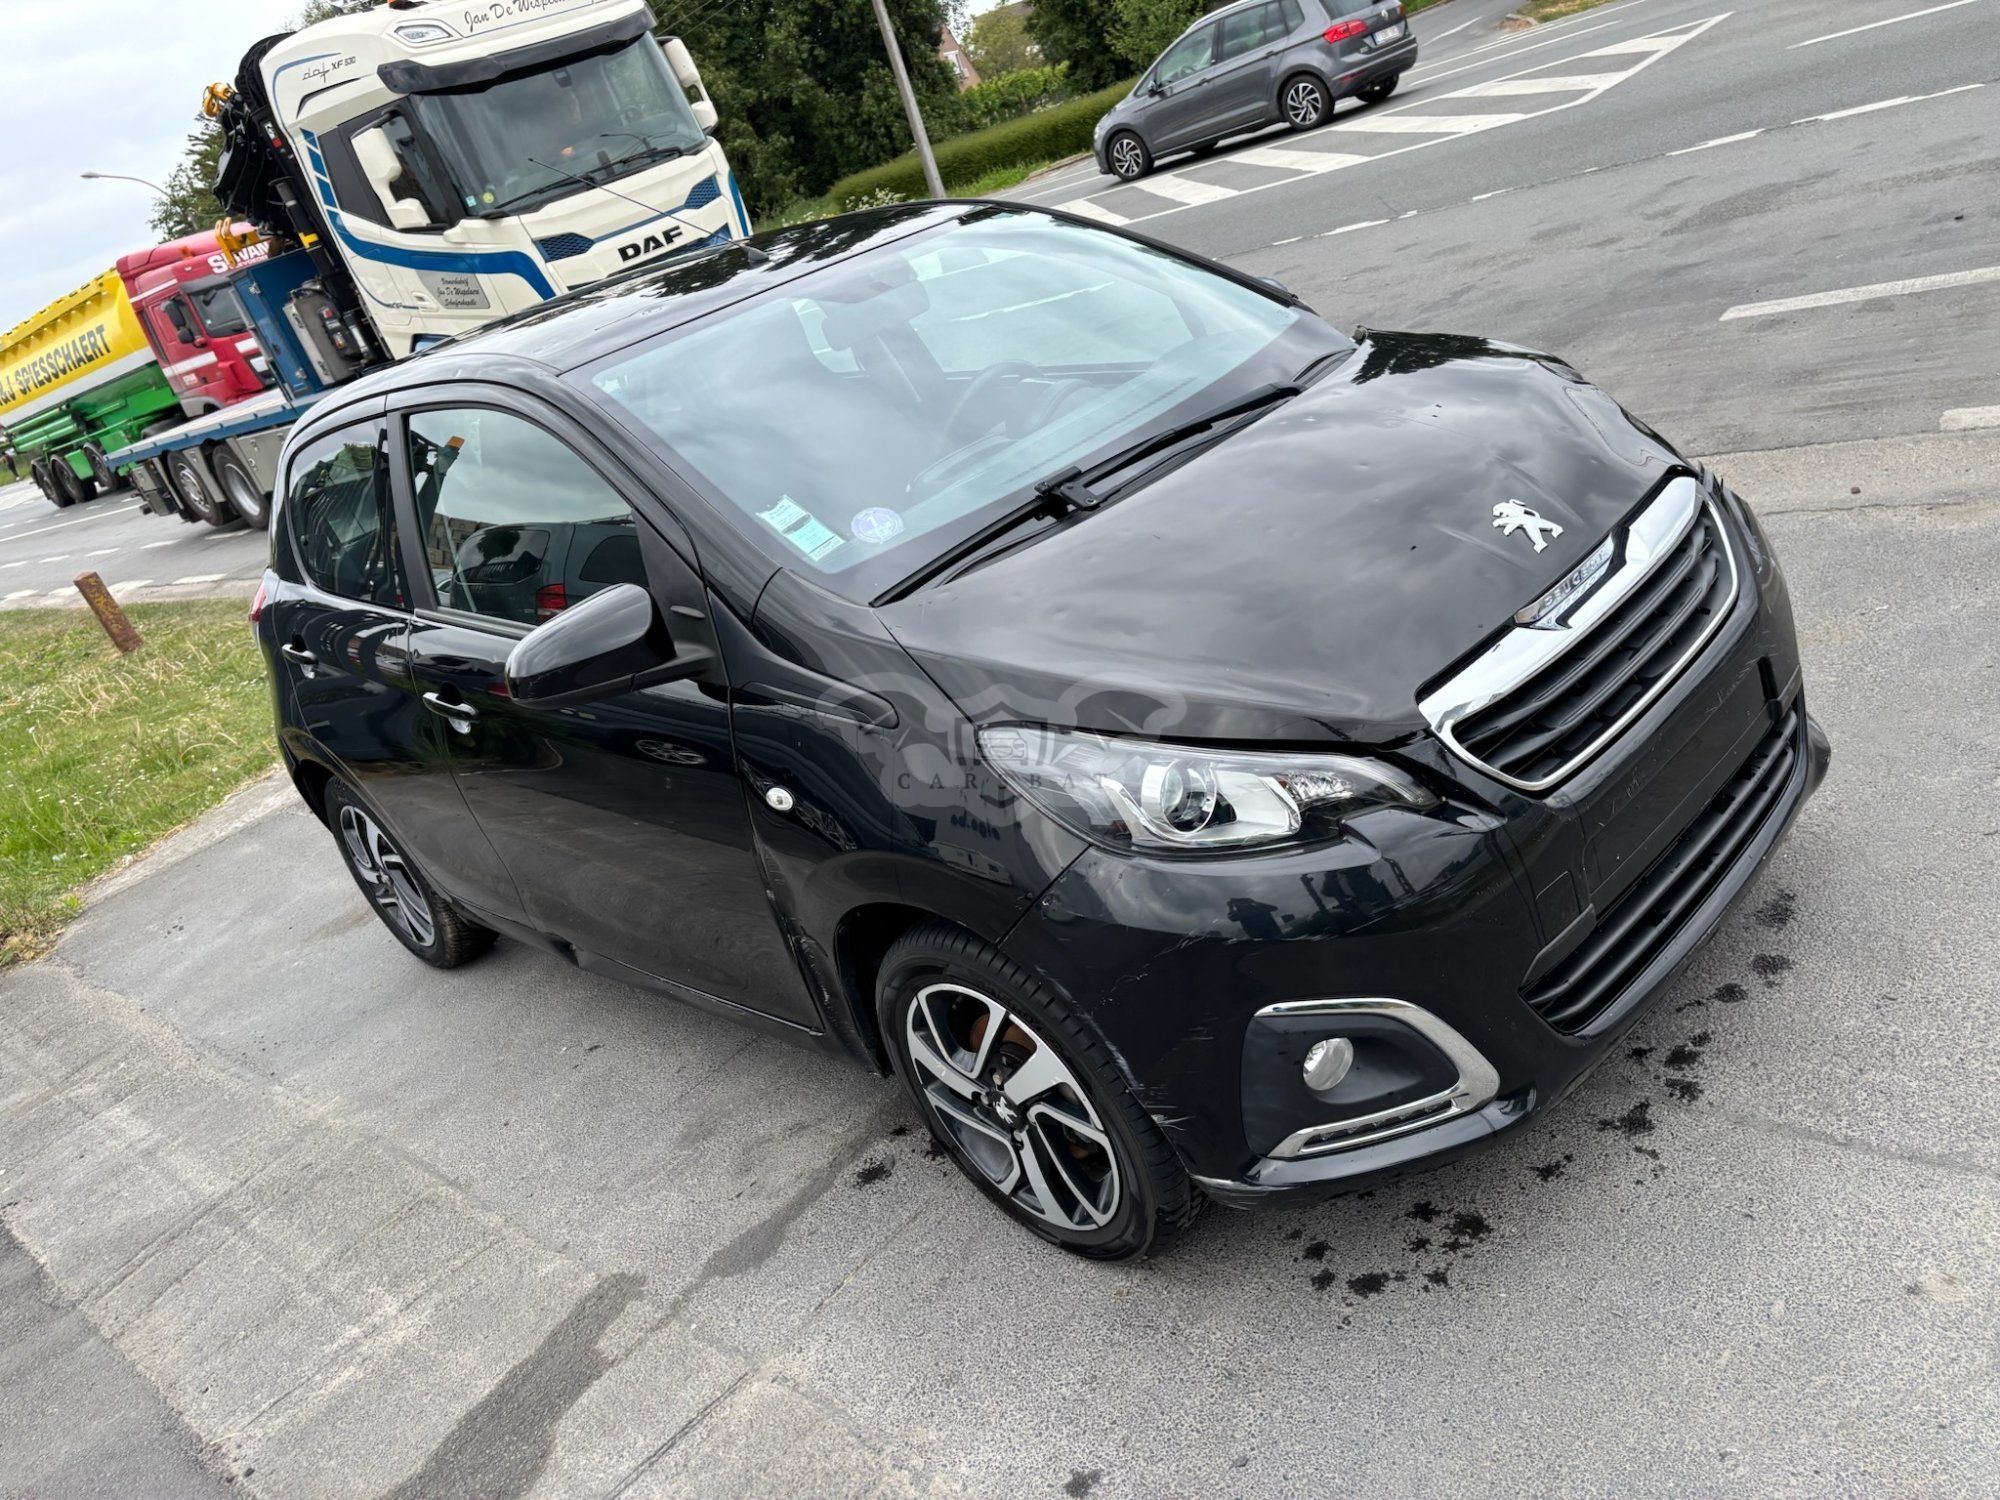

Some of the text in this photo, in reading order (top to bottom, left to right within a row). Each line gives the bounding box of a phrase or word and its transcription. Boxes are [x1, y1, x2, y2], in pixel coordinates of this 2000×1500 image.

[464, 11, 489, 32] Jan
[490, 3, 513, 19] De
[618, 225, 683, 262] DAF
[15, 324, 111, 395] SPIESSCHAERT
